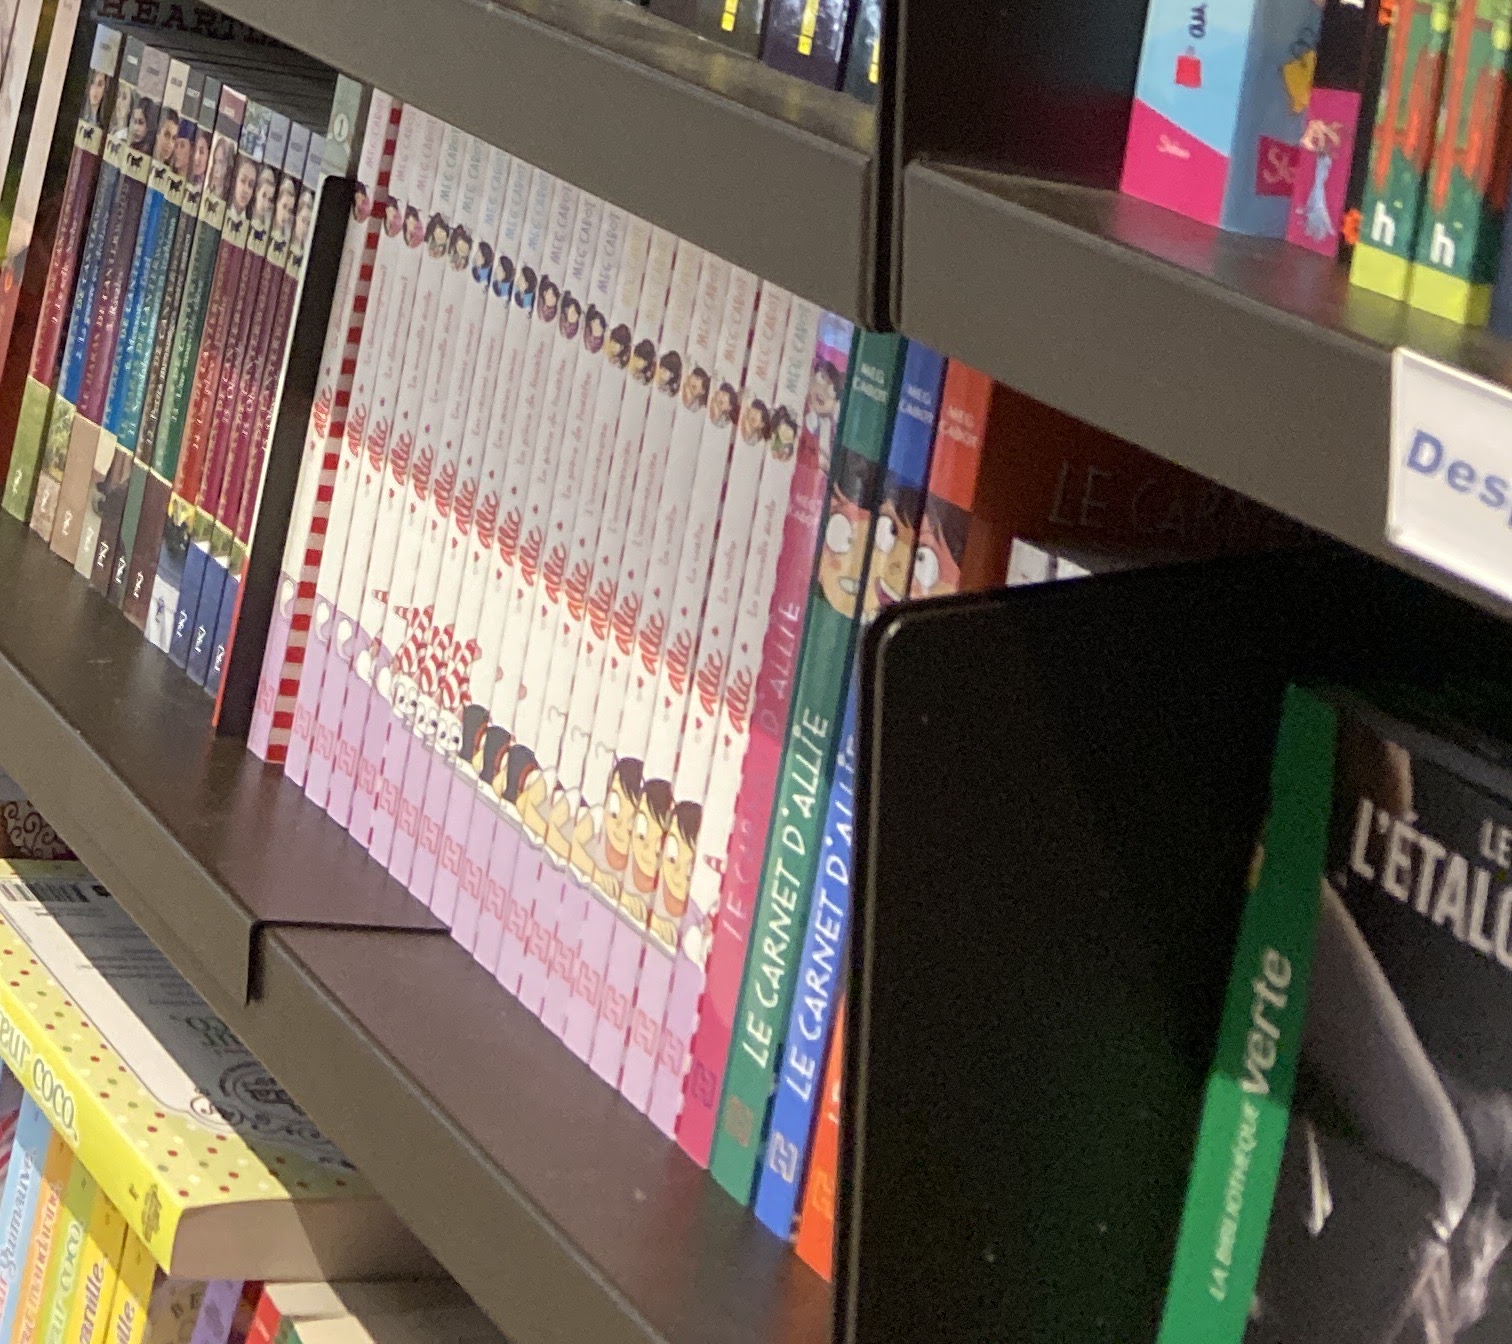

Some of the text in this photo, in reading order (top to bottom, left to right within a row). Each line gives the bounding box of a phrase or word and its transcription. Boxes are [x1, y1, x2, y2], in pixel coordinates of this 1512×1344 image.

[1189, 4, 1207, 39] au
[1406, 428, 1512, 529] Des
[742, 708, 829, 1070] LE CARNET D'ALLIE
[797, 889, 845, 1041] CARNET
[1240, 948, 1293, 1095] verte
[33, 1057, 77, 1138] coco
[786, 1046, 817, 1103] LE
